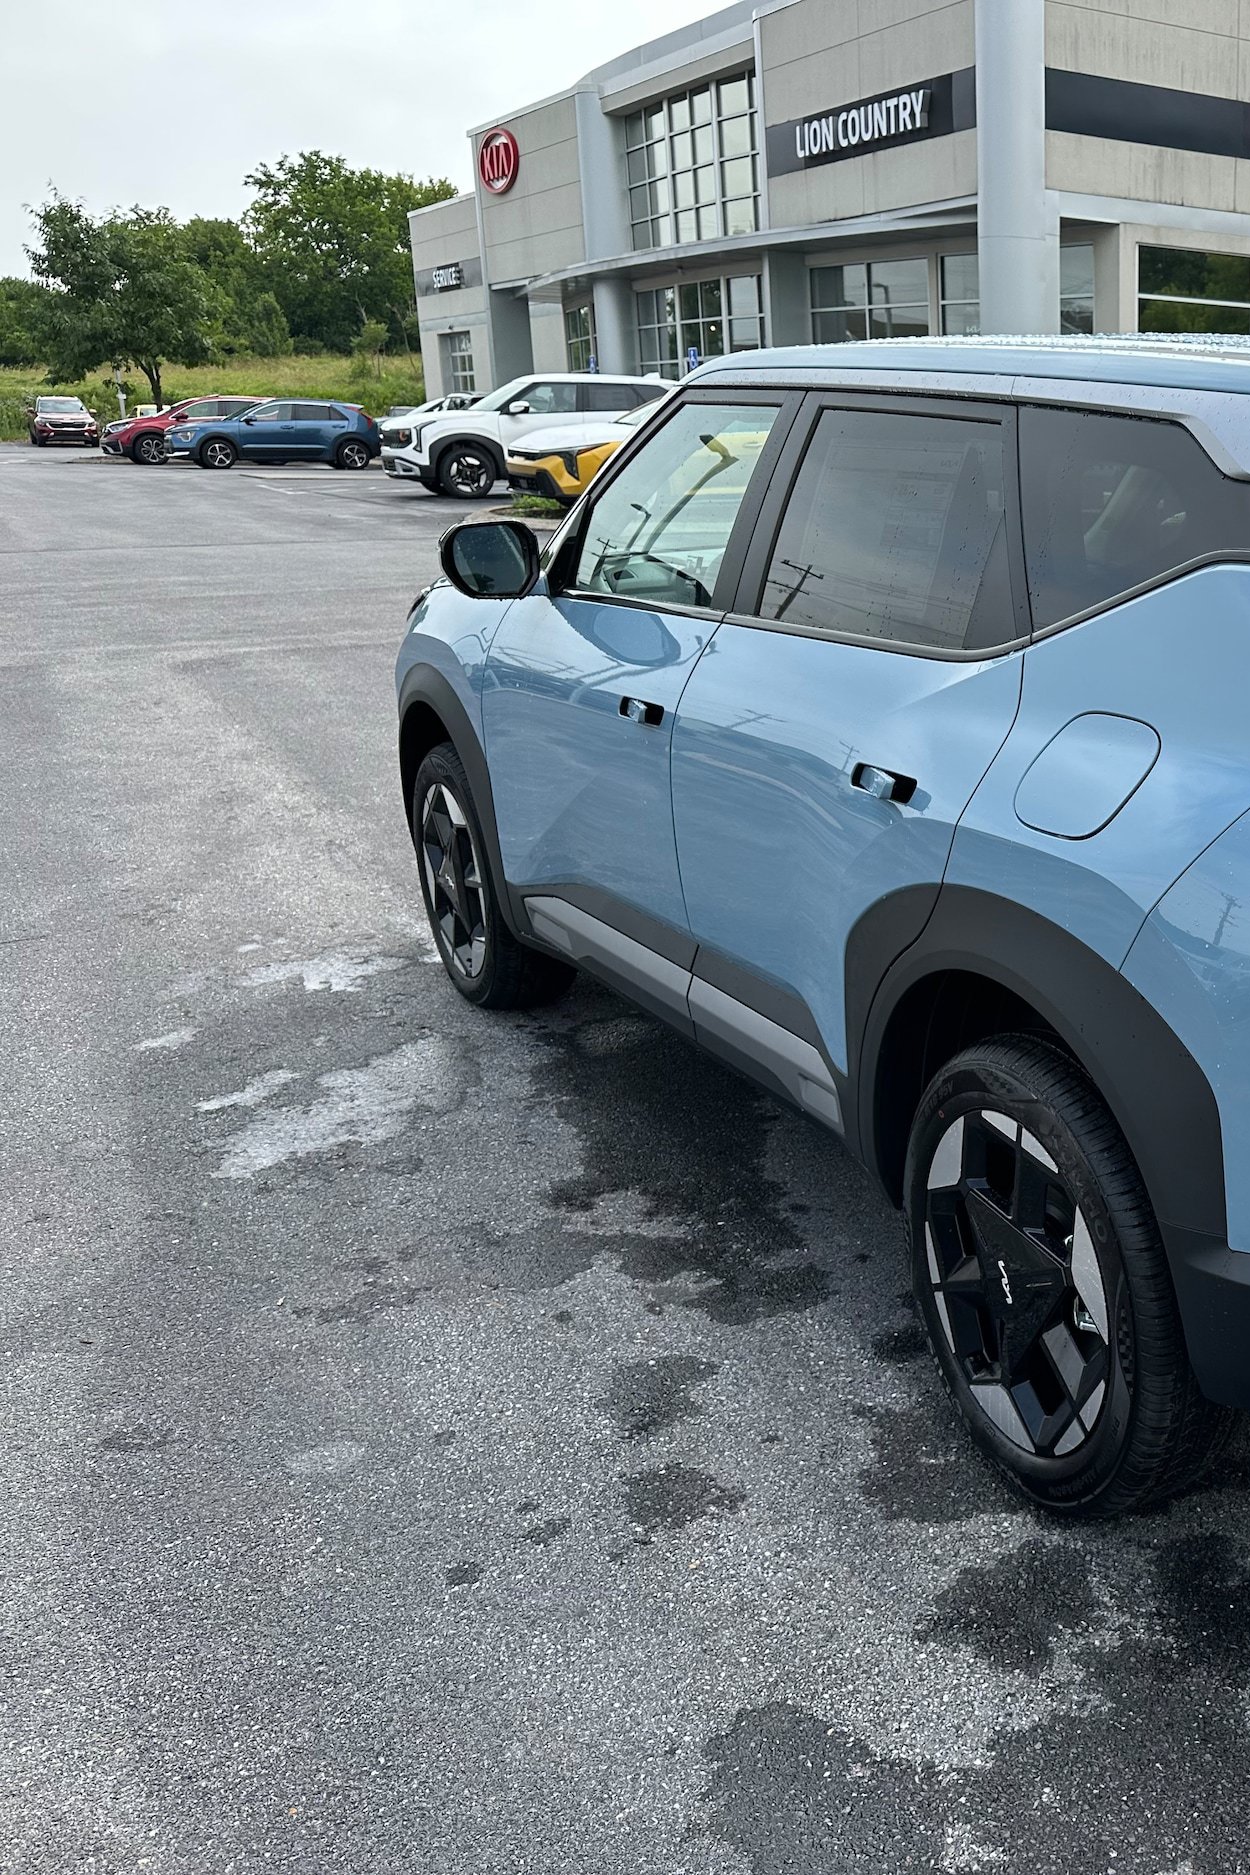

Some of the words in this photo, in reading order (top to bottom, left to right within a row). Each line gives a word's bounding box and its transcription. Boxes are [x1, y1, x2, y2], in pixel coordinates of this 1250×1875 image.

[796, 115, 834, 158] LION
[837, 89, 927, 148] COUNTRY
[482, 141, 509, 182] KIA
[432, 266, 459, 289] SERVICE
